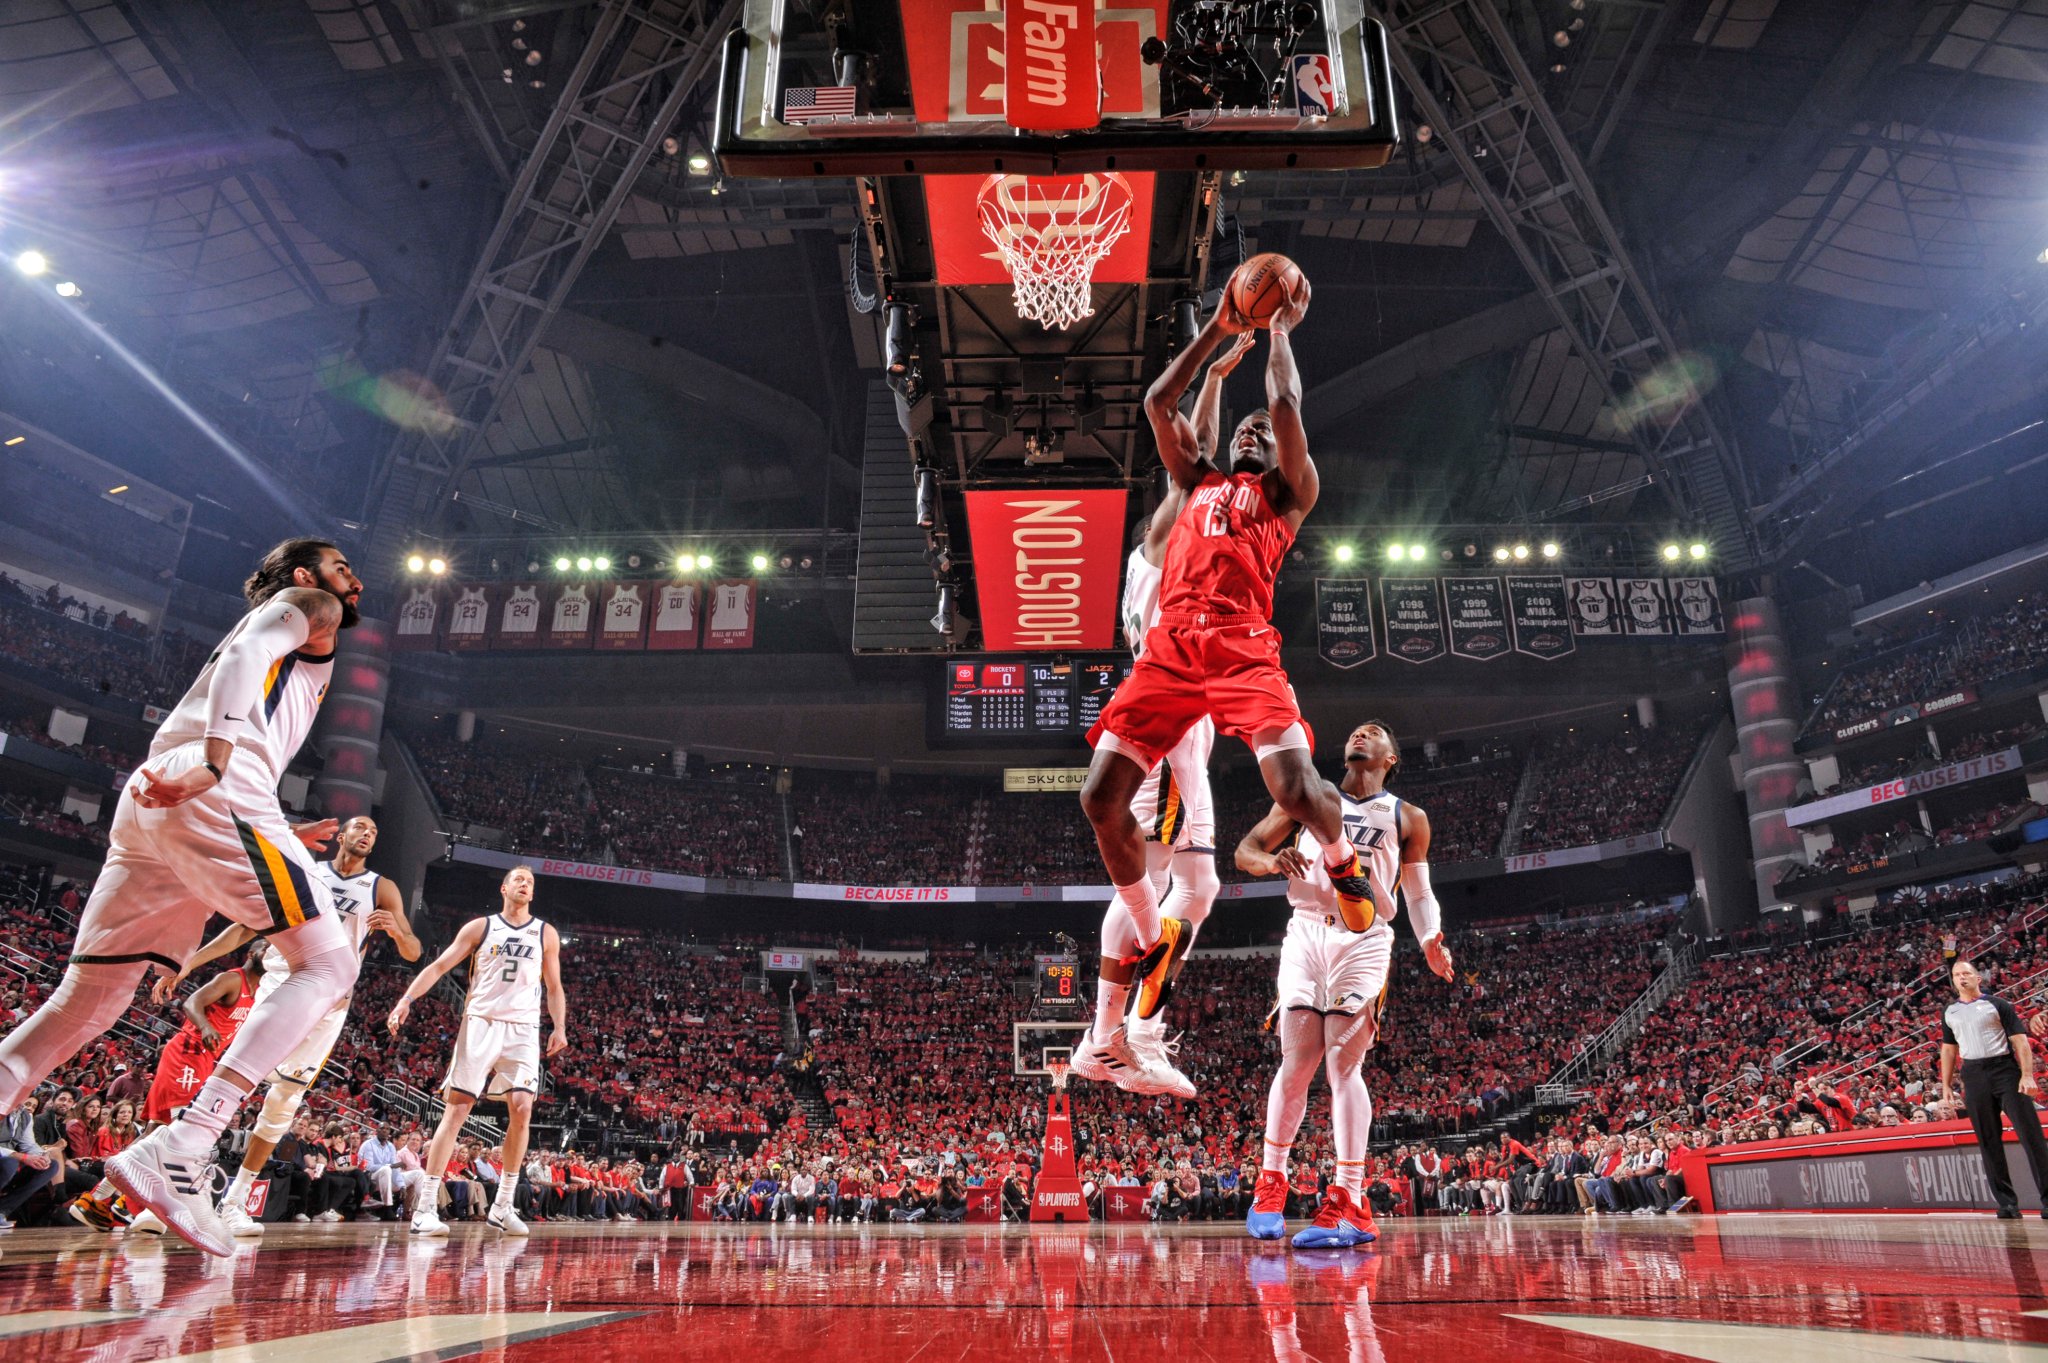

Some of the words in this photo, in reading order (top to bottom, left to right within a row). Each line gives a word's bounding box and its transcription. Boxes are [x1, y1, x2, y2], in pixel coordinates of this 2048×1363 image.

[1023, 0, 1078, 107] Farm
[1302, 105, 1322, 116] NBA
[1203, 501, 1230, 537] 15
[1003, 500, 1088, 645] HOUSTON
[727, 596, 736, 609] 11
[1332, 602, 1353, 611] 1997
[1399, 600, 1424, 609] 1998
[1462, 599, 1487, 608] 1999
[1526, 597, 1552, 606] 2000
[462, 606, 478, 618] 23
[513, 605, 530, 617] 24
[563, 604, 580, 616] 22
[615, 604, 632, 617] 34
[1397, 610, 1428, 619] WNBA
[1461, 609, 1492, 618] WNBA
[1526, 607, 1556, 616] WNBA
[1588, 604, 1599, 613] 10
[1329, 612, 1358, 622] WNBA
[1517, 618, 1568, 627] Champions
[1320, 622, 1369, 634] Champions
[1389, 621, 1439, 631] Champions
[1453, 620, 1503, 629] Champions
[1002, 673, 1011, 686] 0
[1099, 672, 1108, 685] 2
[1836, 719, 1879, 739] CLUTCH'S
[1027, 775, 1055, 784] SKY
[1057, 775, 1088, 784] COU
[1871, 767, 1959, 803] BECAUSE
[1964, 760, 1982, 778] IT
[1987, 754, 2007, 773] IS
[1513, 857, 1527, 870] IT
[1532, 854, 1547, 867] IS
[542, 860, 617, 881] BECAUSE
[619, 869, 635, 882] IT
[637, 871, 653, 885] IS
[845, 887, 914, 900] BECAUSE
[917, 888, 932, 900] IT
[934, 888, 949, 900] IS
[1229, 885, 1243, 897] IS
[502, 959, 518, 983] 2
[1047, 966, 1074, 977] 10:36
[1060, 977, 1071, 996] 8
[228, 1006, 251, 1021] HOUS
[1809, 1160, 1870, 1204] PLAYOFFS
[1918, 1153, 1998, 1202] PLAYOFF
[1724, 1167, 1771, 1206] PLAYOFFS
[1045, 1192, 1080, 1207] PLAYOFFS
